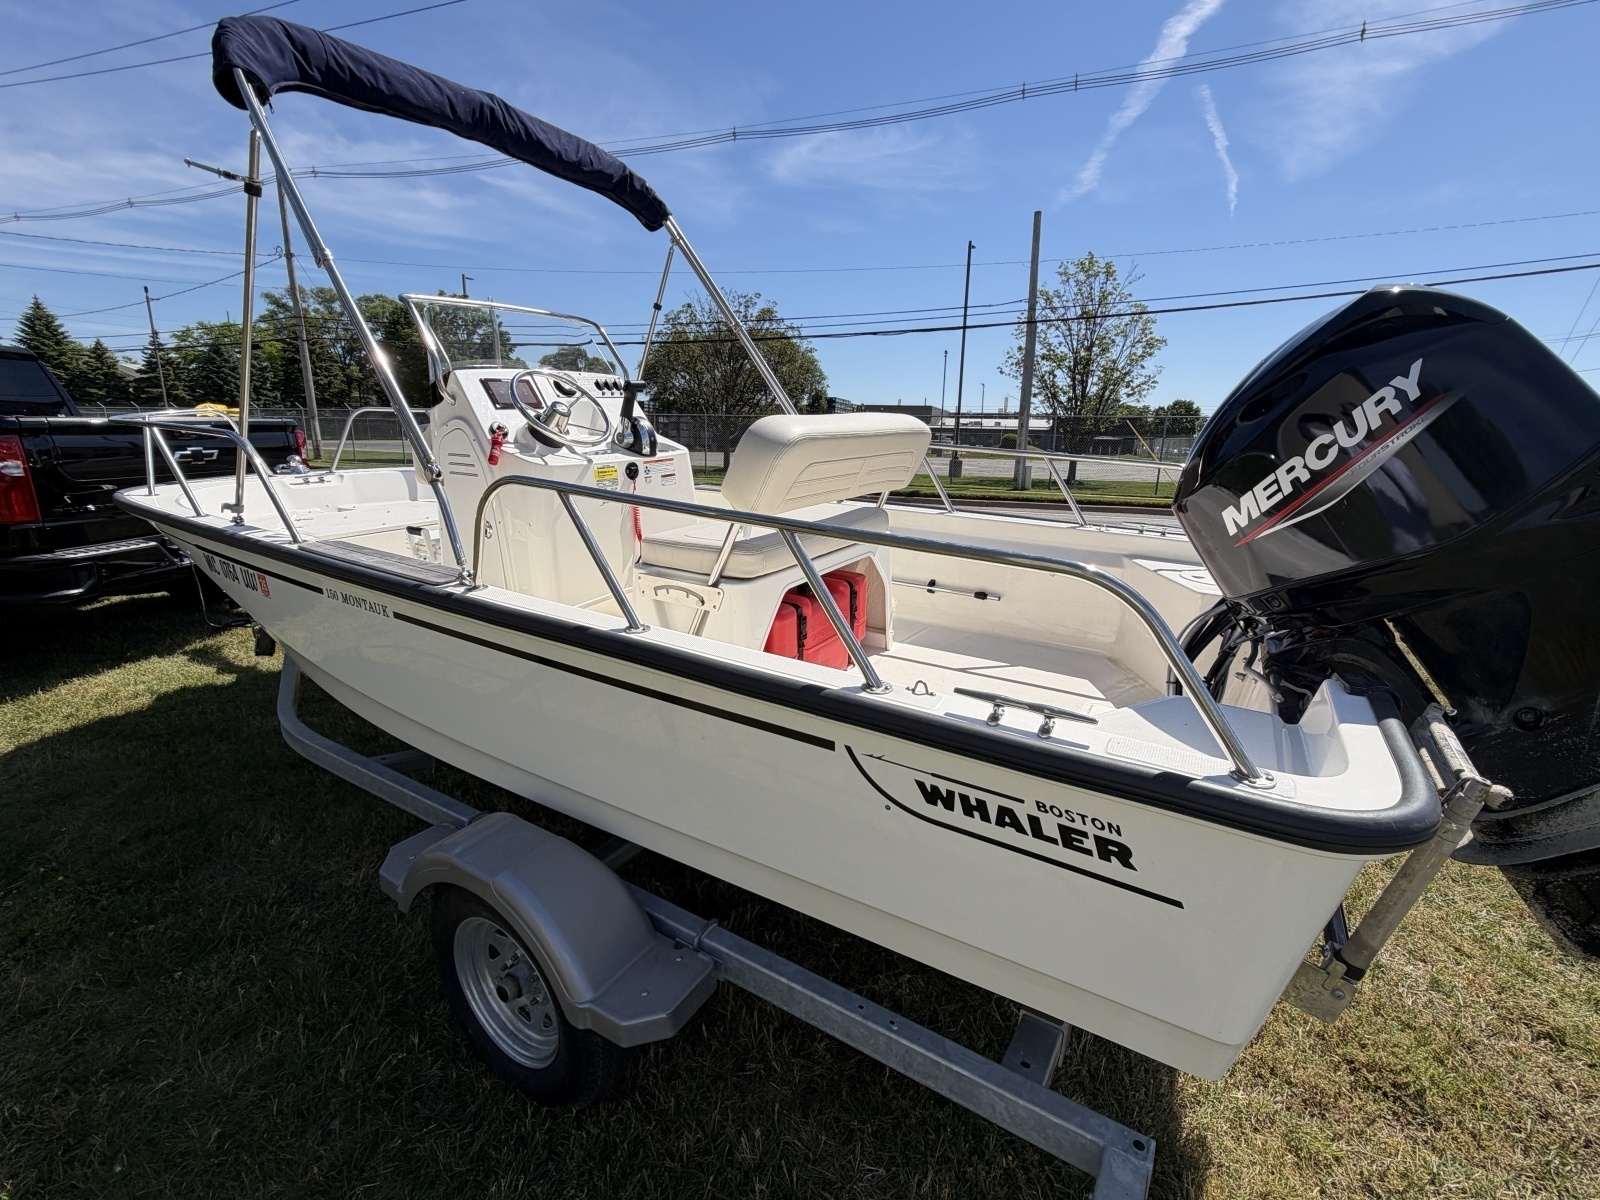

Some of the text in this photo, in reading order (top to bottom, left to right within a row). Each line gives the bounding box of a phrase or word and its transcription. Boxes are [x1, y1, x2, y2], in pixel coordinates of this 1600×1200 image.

[1221, 358, 1423, 537] MERCURY
[1349, 413, 1429, 475] FOURSTROKE
[326, 588, 390, 618] 150 MONTAUK
[914, 778, 1138, 872] WHALER
[1035, 800, 1122, 837] BOSTON
